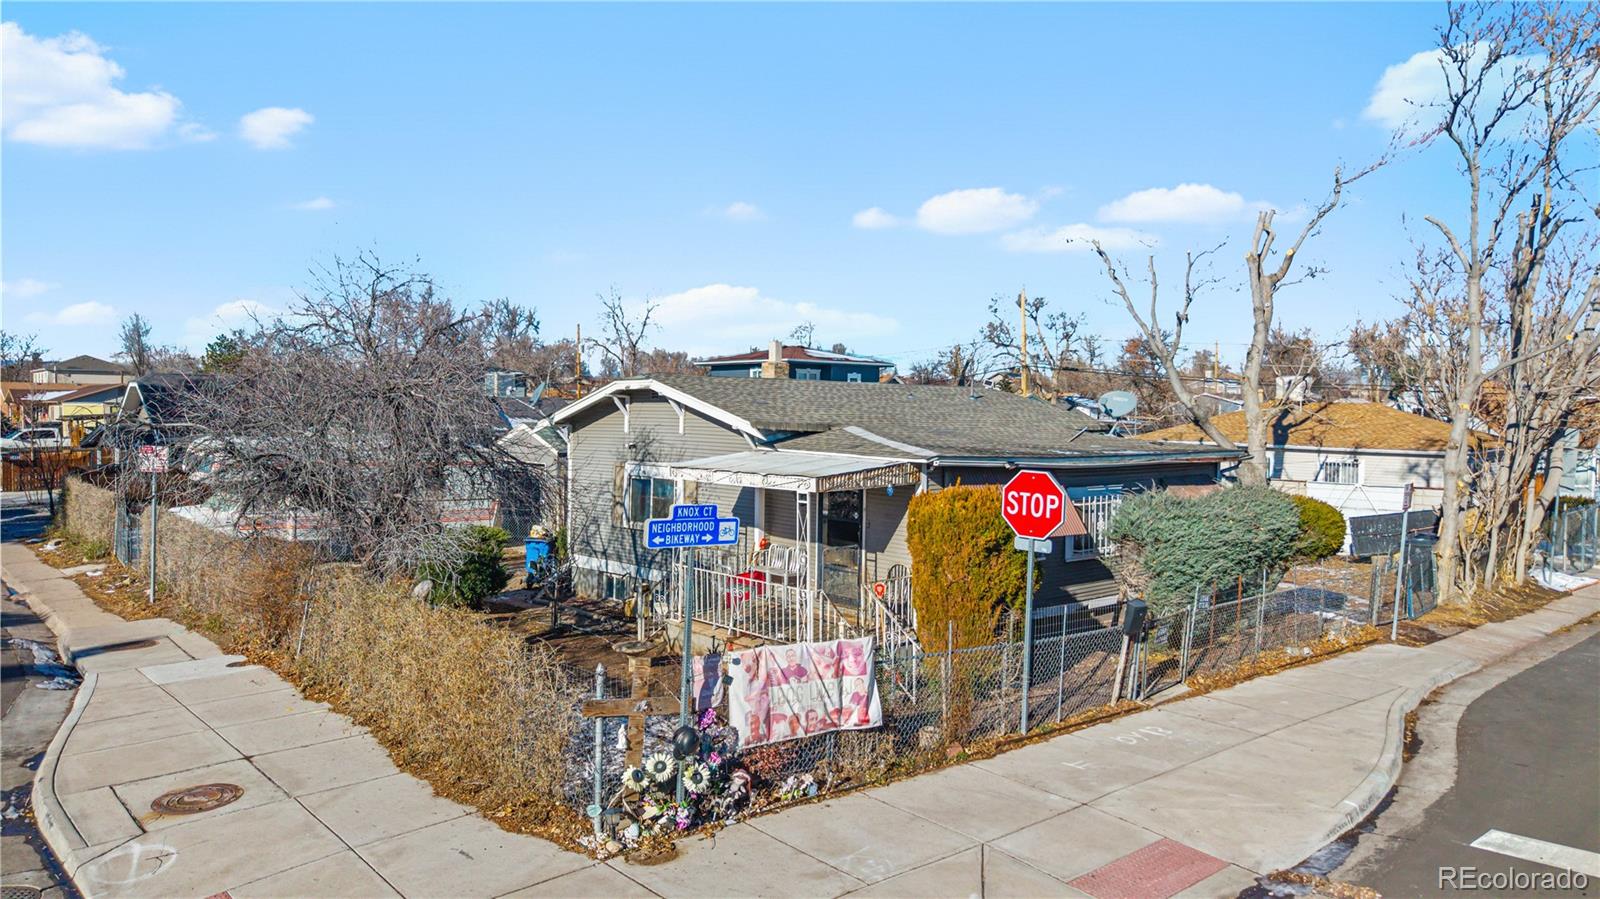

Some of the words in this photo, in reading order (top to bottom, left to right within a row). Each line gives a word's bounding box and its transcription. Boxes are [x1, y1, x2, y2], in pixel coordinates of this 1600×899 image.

[1006, 490, 1059, 519] STOP
[677, 506, 700, 518] KNOX
[703, 506, 713, 517] CT
[651, 521, 715, 534] NEIGHBORHOOD
[665, 533, 700, 545] BIKEWAY
